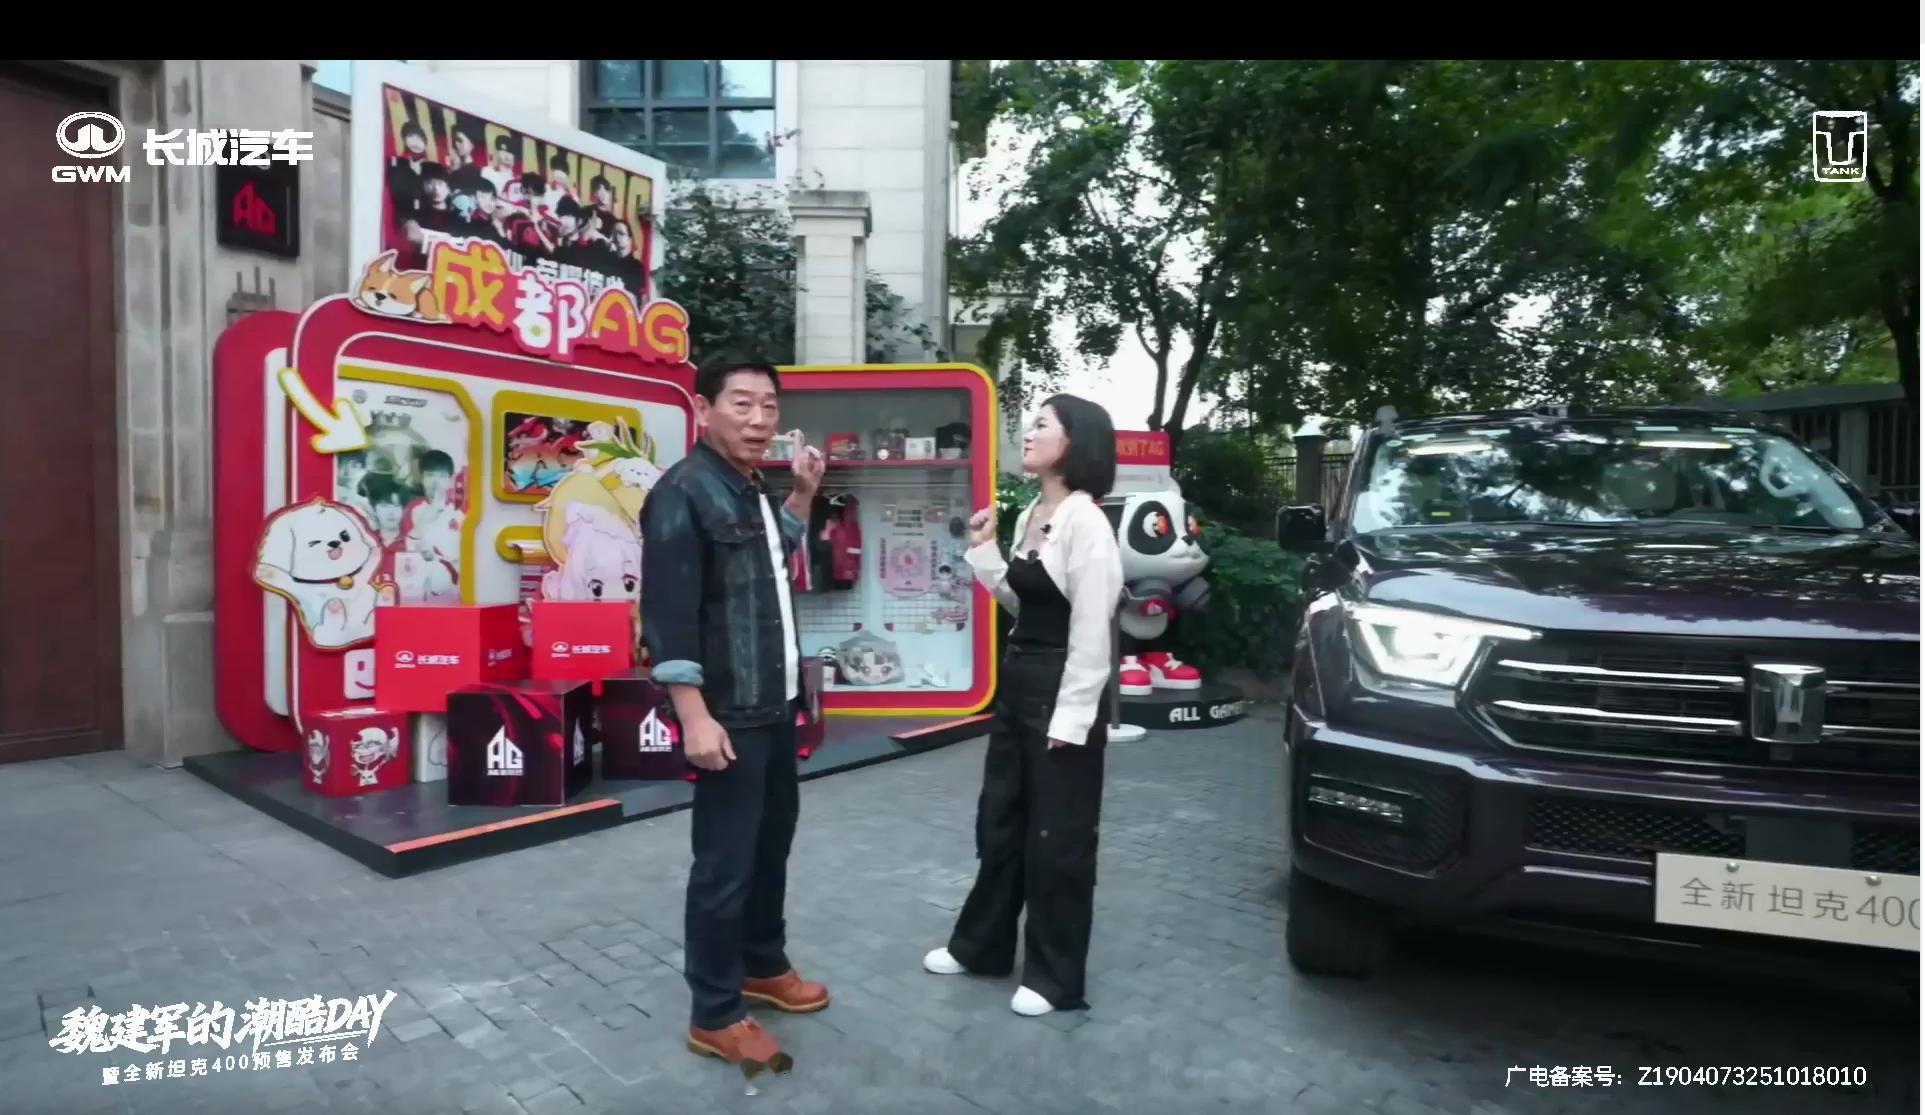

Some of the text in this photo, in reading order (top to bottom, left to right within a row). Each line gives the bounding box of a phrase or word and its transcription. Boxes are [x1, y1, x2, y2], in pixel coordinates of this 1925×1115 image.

[434, 244, 687, 357] 成都AG
[639, 706, 673, 746] AG
[1169, 706, 1201, 723] ALL
[487, 725, 524, 769] AG
